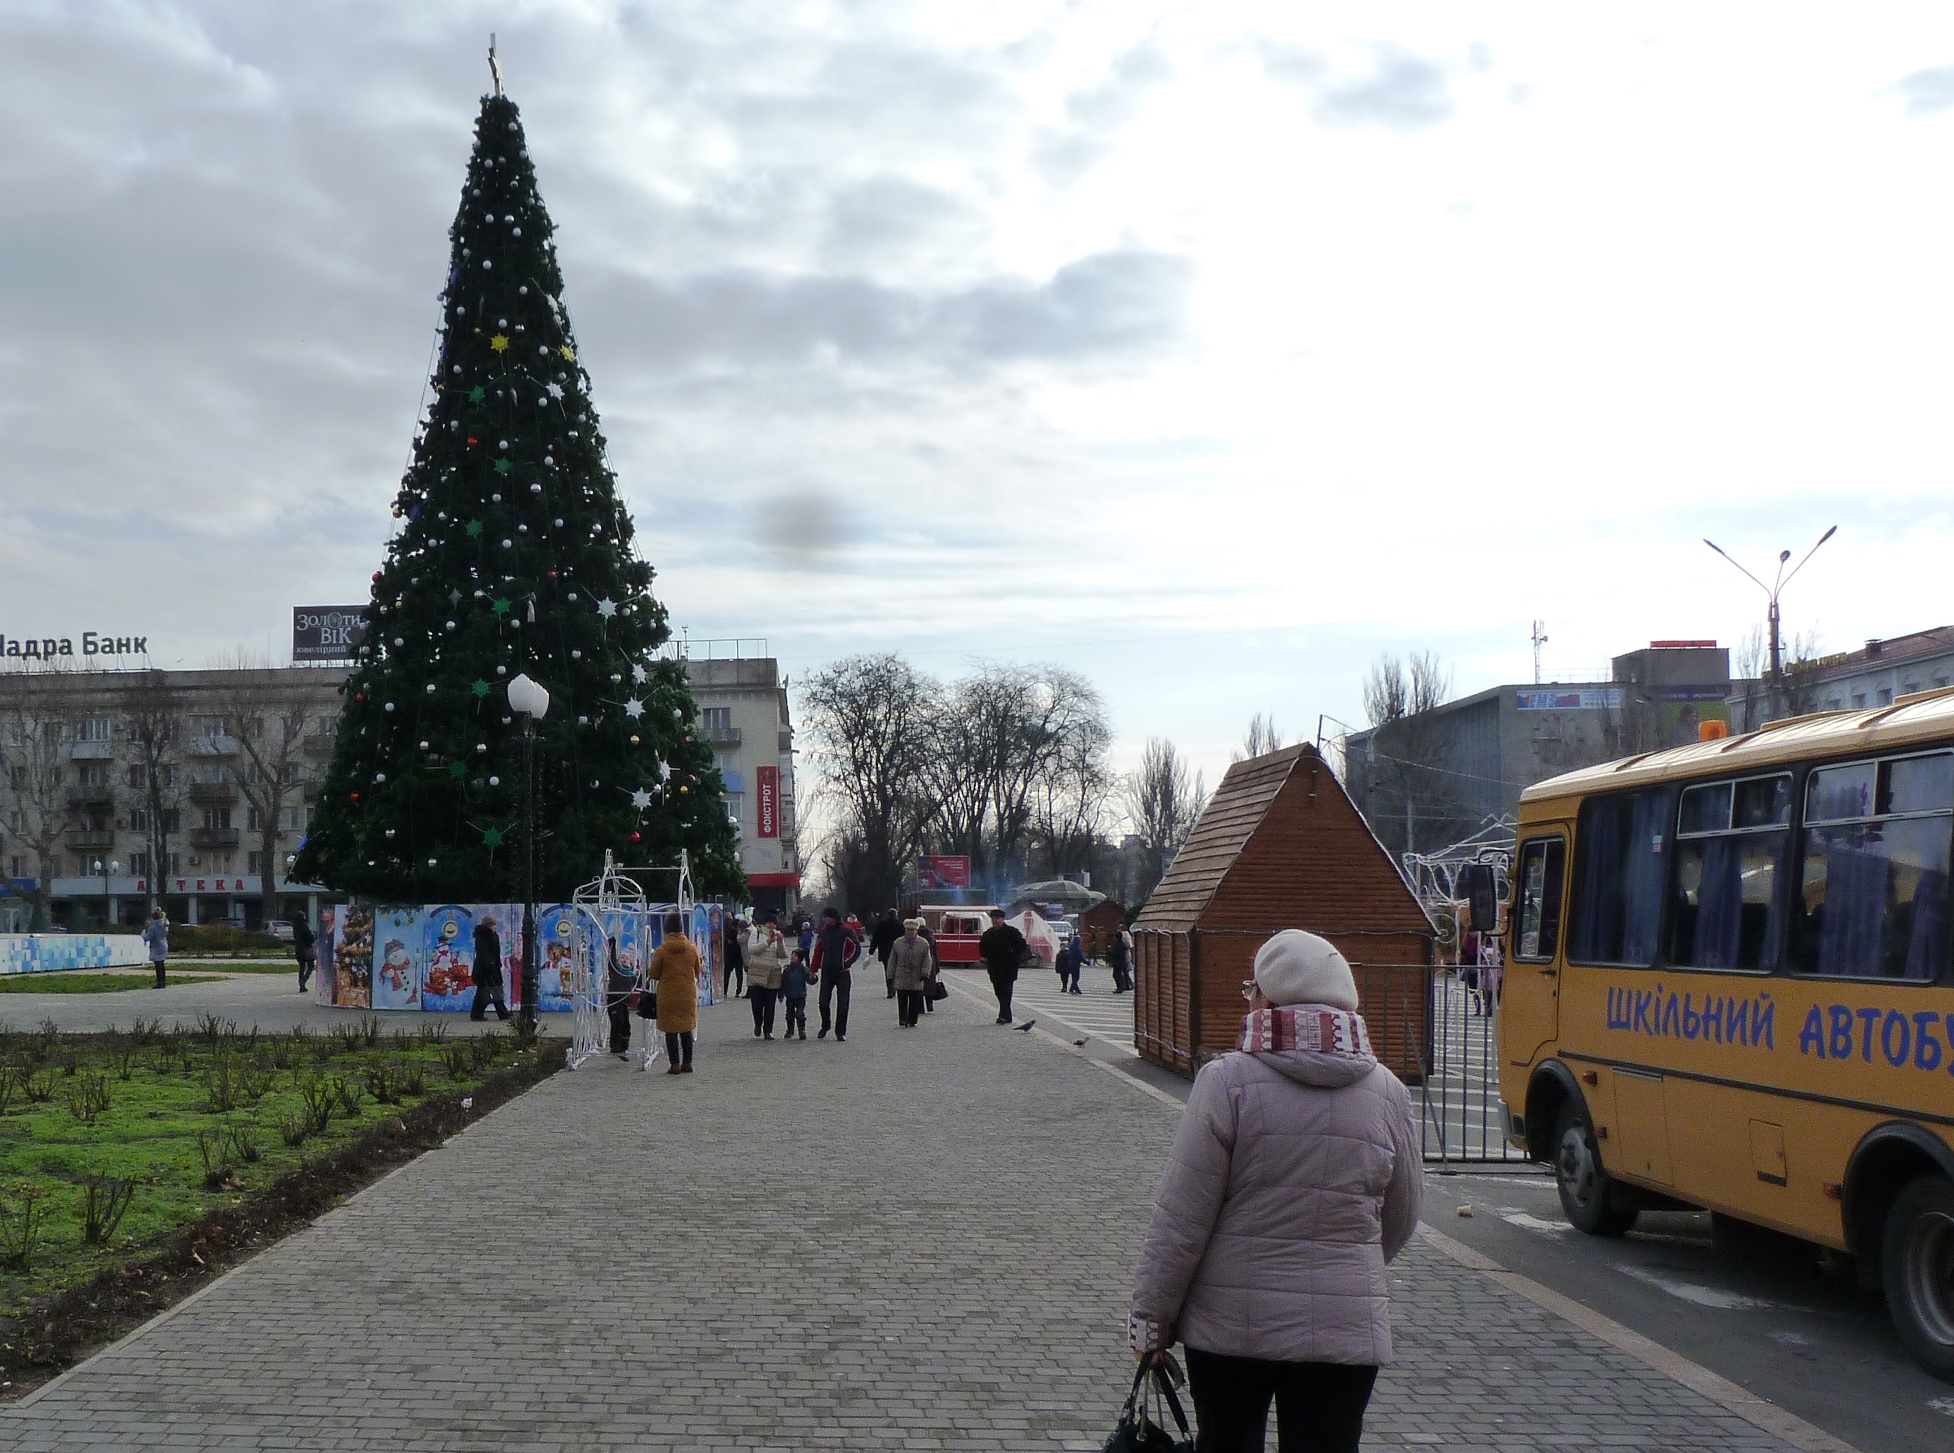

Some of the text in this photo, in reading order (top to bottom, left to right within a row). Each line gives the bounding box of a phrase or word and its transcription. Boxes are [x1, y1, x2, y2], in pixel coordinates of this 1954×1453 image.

[82, 631, 147, 655] Банк
[762, 783, 772, 833] ФОКСТРОТ
[136, 879, 245, 892] АТЕКА
[1799, 1004, 1954, 1077] АВТОБ
